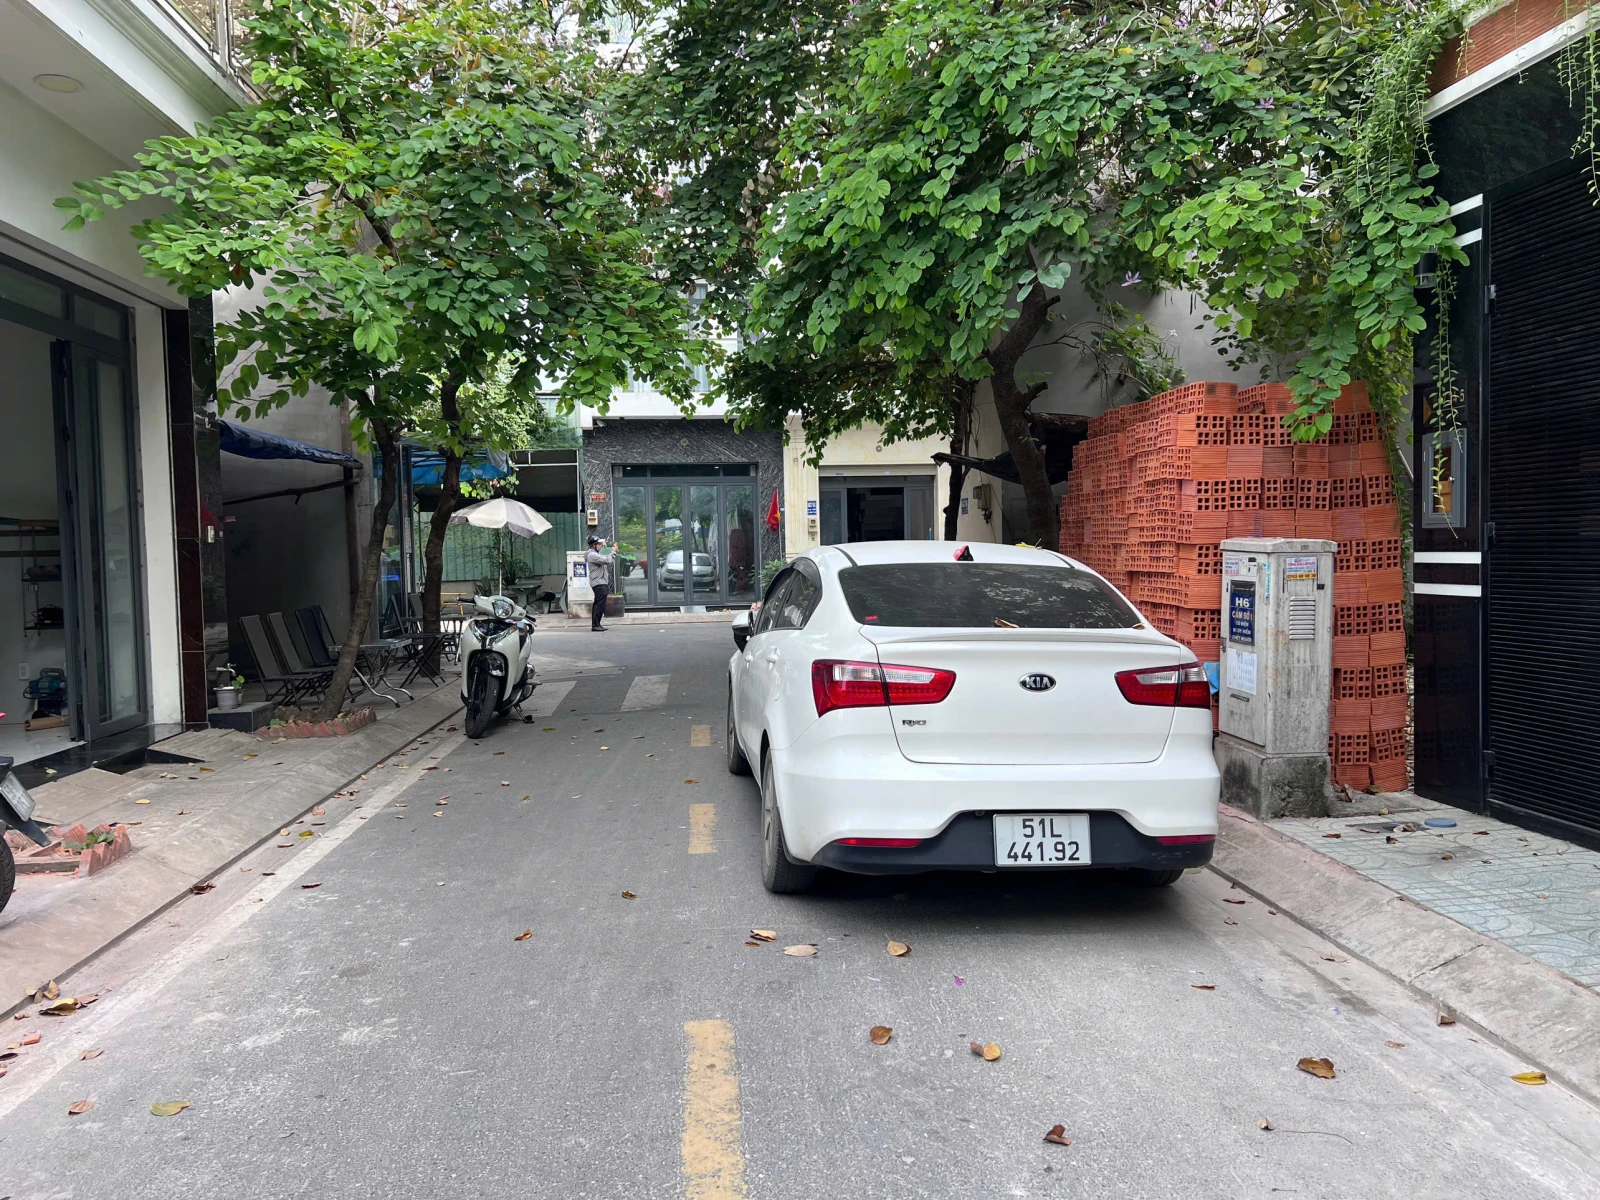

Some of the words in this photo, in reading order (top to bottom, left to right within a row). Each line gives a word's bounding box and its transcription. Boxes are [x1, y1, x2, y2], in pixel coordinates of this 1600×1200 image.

[1235, 597, 1250, 608] H6
[1025, 676, 1051, 688] KIA
[1022, 818, 1063, 838] 51L
[1007, 841, 1081, 862] 441.92
